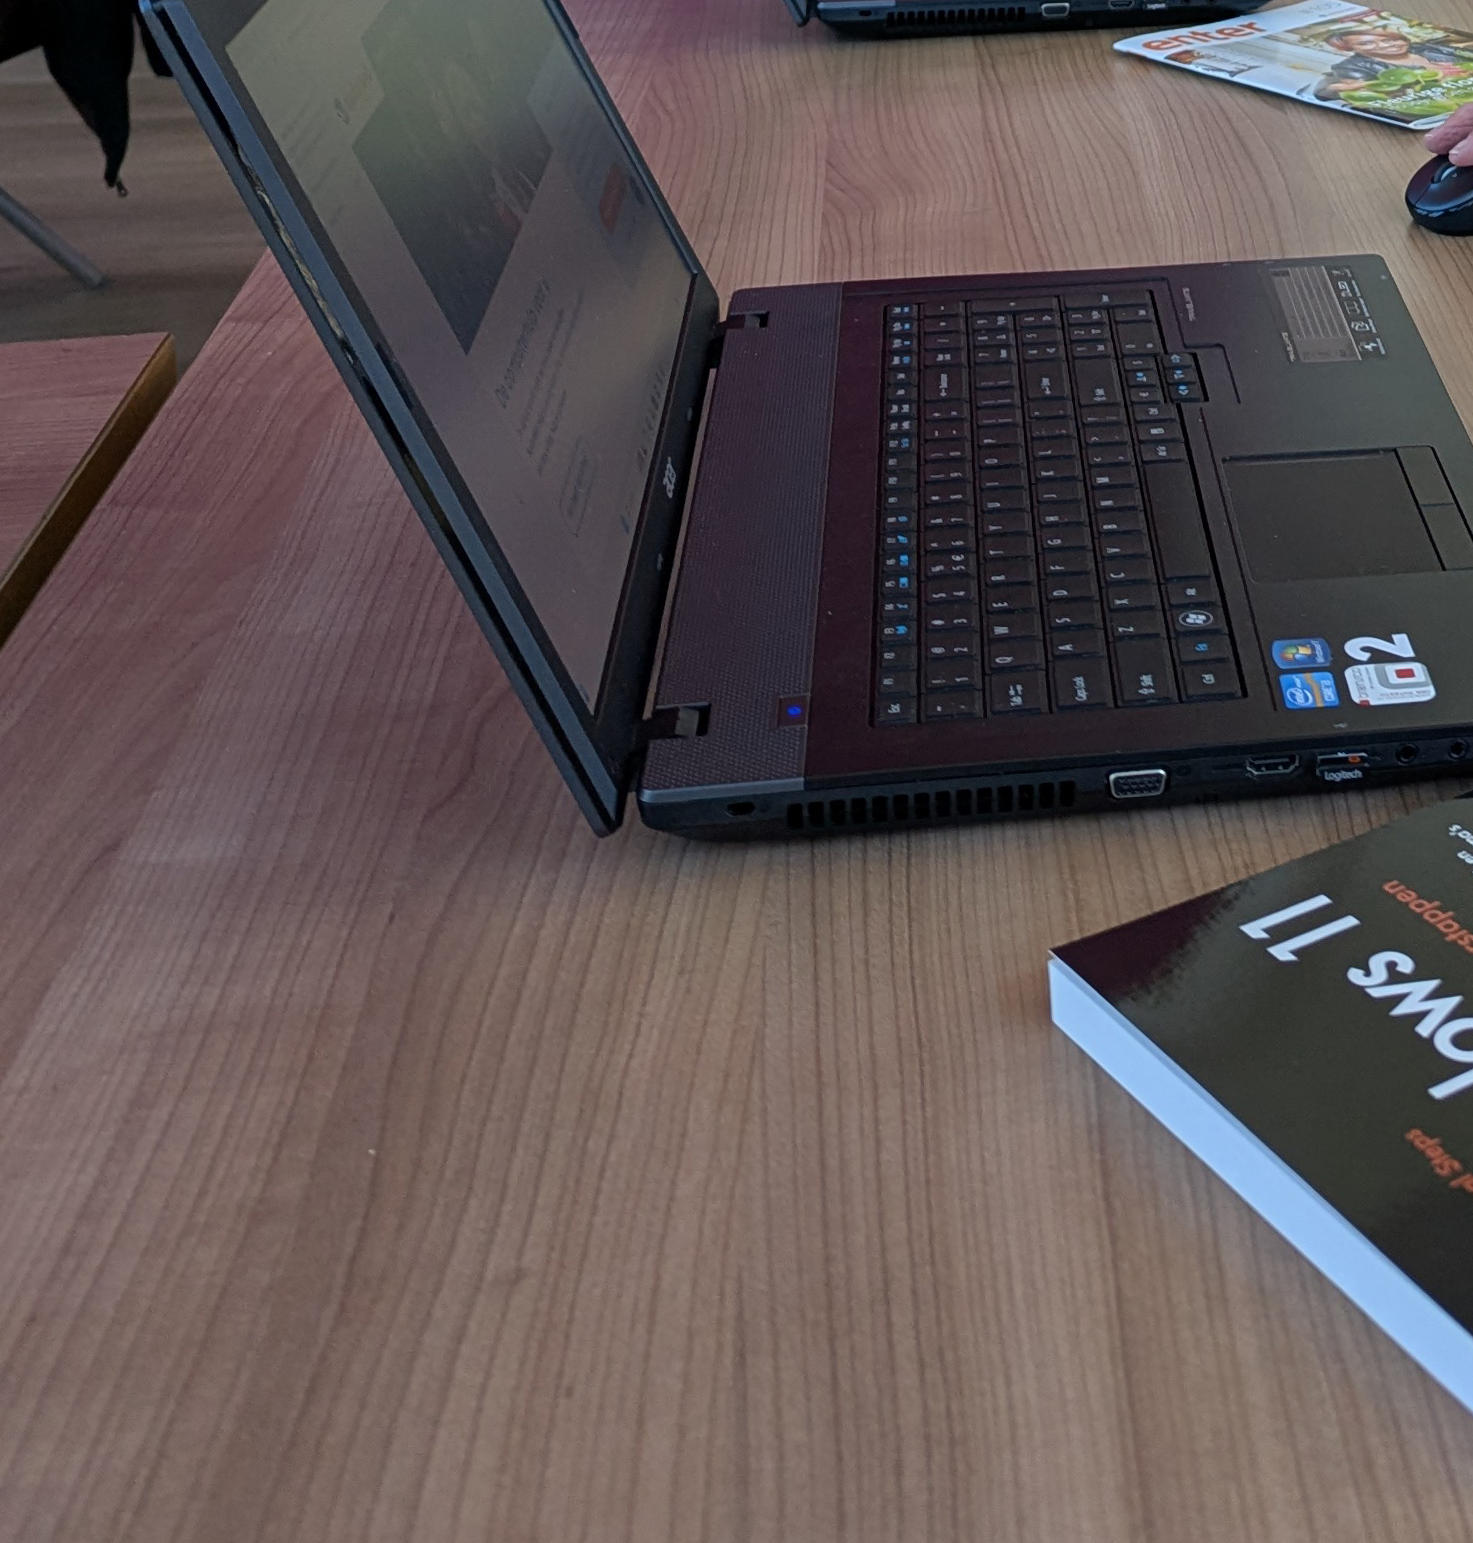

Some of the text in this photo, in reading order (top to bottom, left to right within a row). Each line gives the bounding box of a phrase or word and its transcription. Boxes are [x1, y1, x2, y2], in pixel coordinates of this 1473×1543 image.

[1142, 20, 1266, 51] enter
[994, 626, 1009, 635] W
[1344, 633, 1416, 662] 2
[1324, 769, 1363, 783] Logitech
[1239, 894, 1360, 961] 11
[1405, 1128, 1460, 1176] Steps
